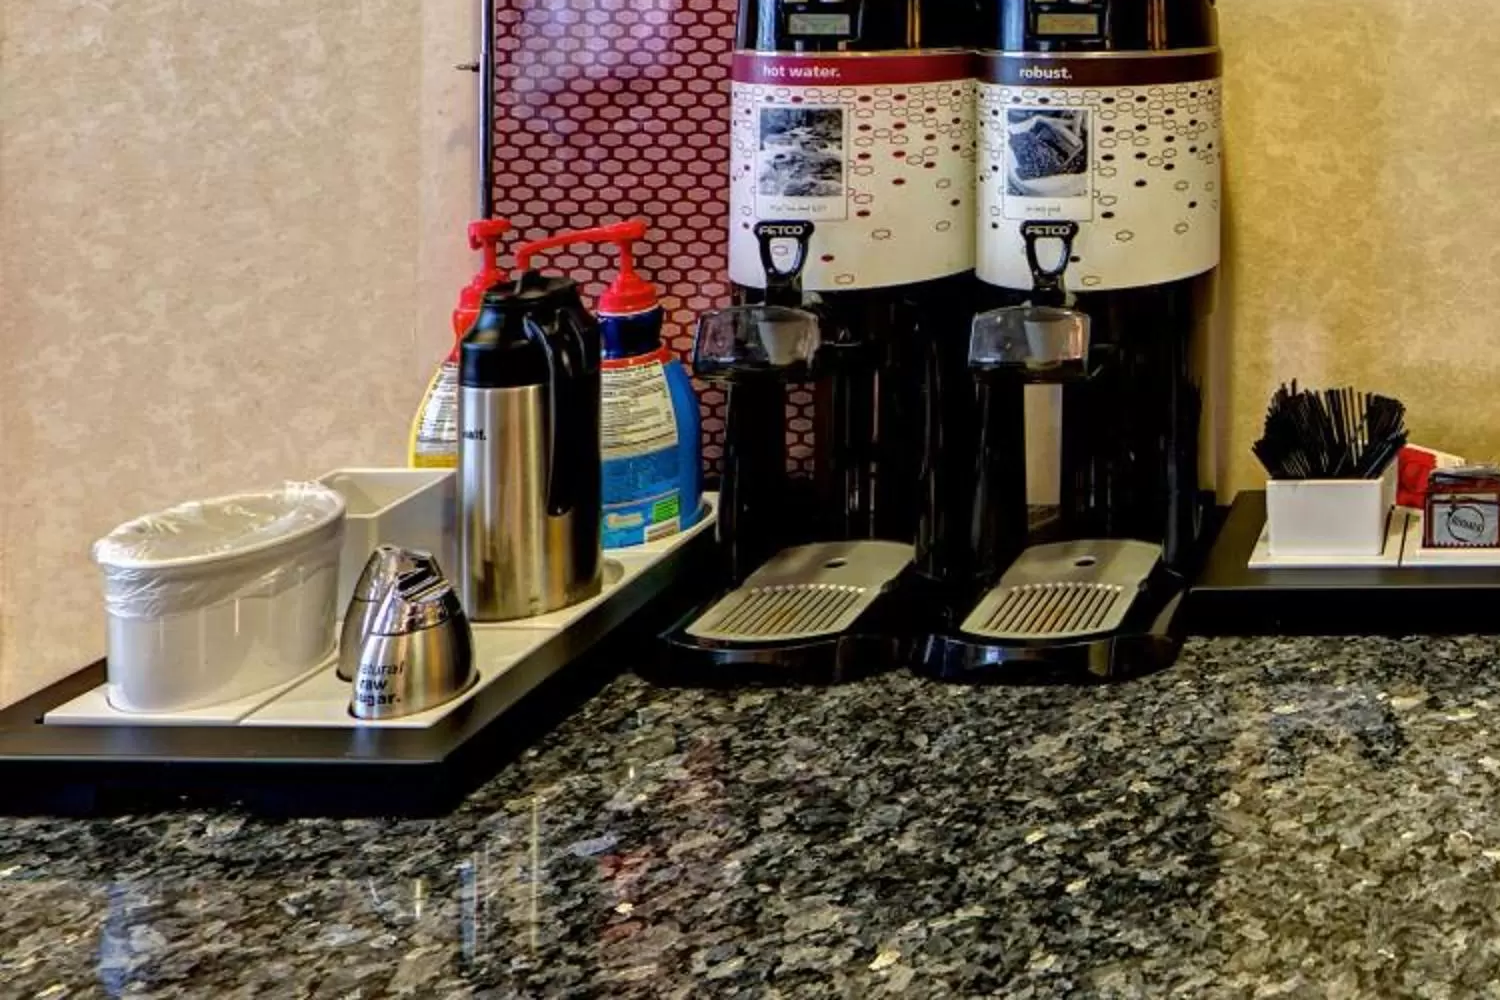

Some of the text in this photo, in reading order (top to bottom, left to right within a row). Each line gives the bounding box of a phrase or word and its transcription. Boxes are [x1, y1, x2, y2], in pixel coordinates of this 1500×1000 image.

[763, 63, 841, 78] hot water.
[1018, 65, 1073, 79] robust.
